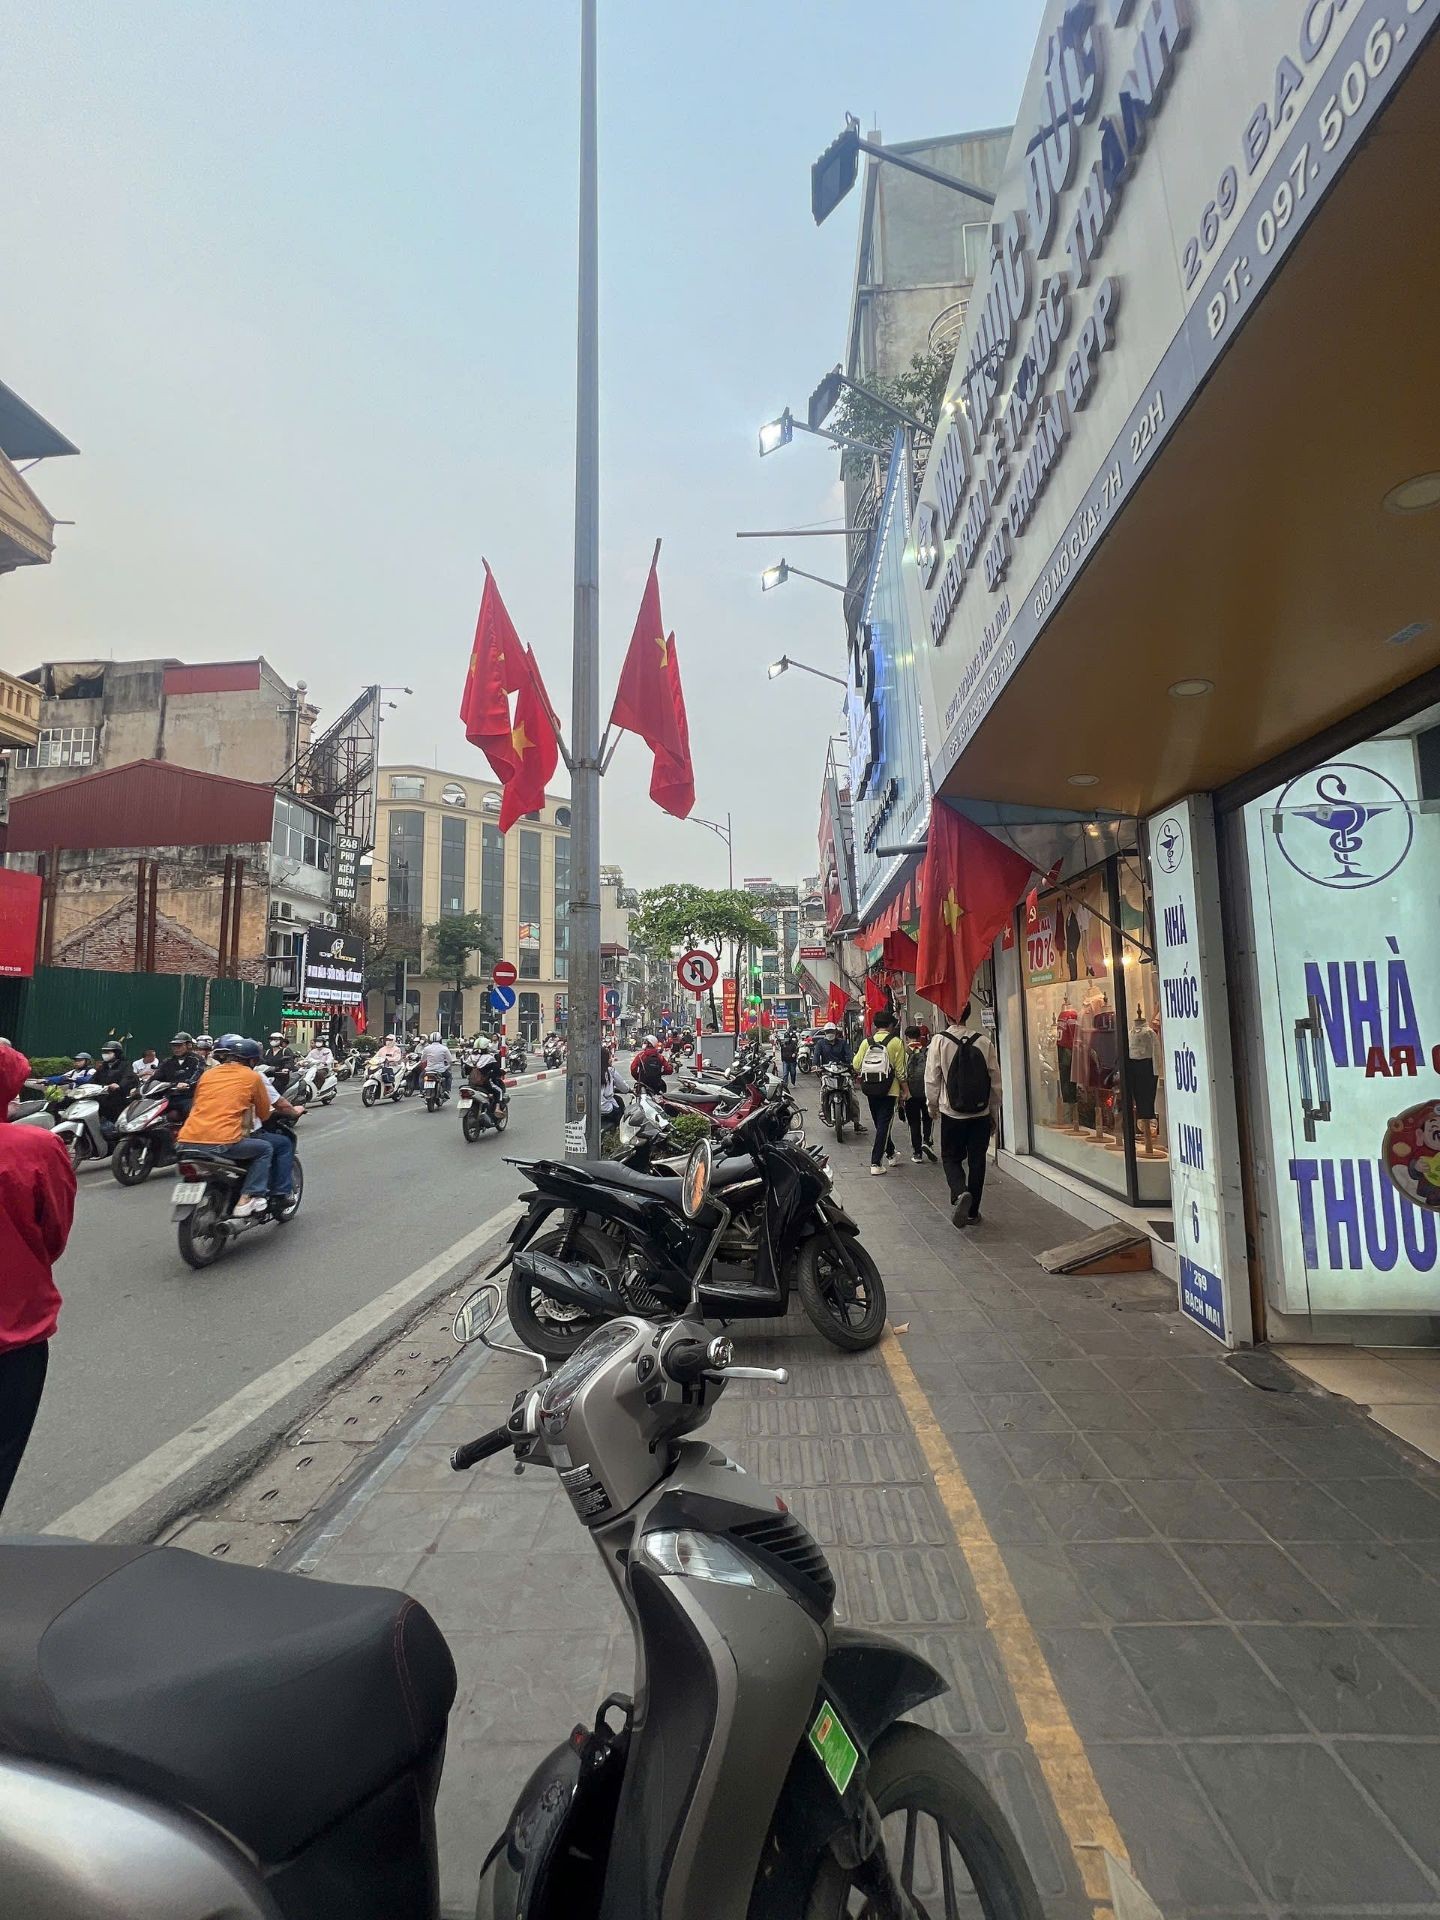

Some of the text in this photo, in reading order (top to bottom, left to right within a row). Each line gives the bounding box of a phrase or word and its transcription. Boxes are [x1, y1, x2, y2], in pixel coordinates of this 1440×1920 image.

[1183, 0, 1348, 290] 269 BẠC
[1207, 18, 1407, 339] ĐT: 097. 506.
[955, 212, 1024, 450] THUỐC
[1024, 4, 1096, 258] ĐỨC
[932, 546, 963, 643] CHUYÊN
[961, 482, 989, 567] BÁN
[1004, 273, 1065, 450] THUỐC
[983, 277, 1113, 592] ĐẠT CHUẨN GPP
[1034, 573, 1051, 619] GIỜ
[1101, 461, 1123, 509] 7H
[1131, 390, 1166, 465] 22H
[991, 595, 1011, 644] LINH
[340, 838, 358, 849] 248
[340, 851, 355, 863] PHỤ
[335, 888, 355, 899] THOẠI
[1164, 895, 1188, 947] NHÀ
[1027, 932, 1055, 971] 70%
[1163, 962, 1199, 1019] THUỐC
[1304, 936, 1425, 1068] NHÀ
[1174, 1042, 1197, 1093] ĐỨC
[1178, 1123, 1204, 1171] LINH
[1191, 1201, 1200, 1244] 6
[1193, 1269, 1208, 1292] 269
[1185, 1288, 1220, 1329] BẠCH MAI
